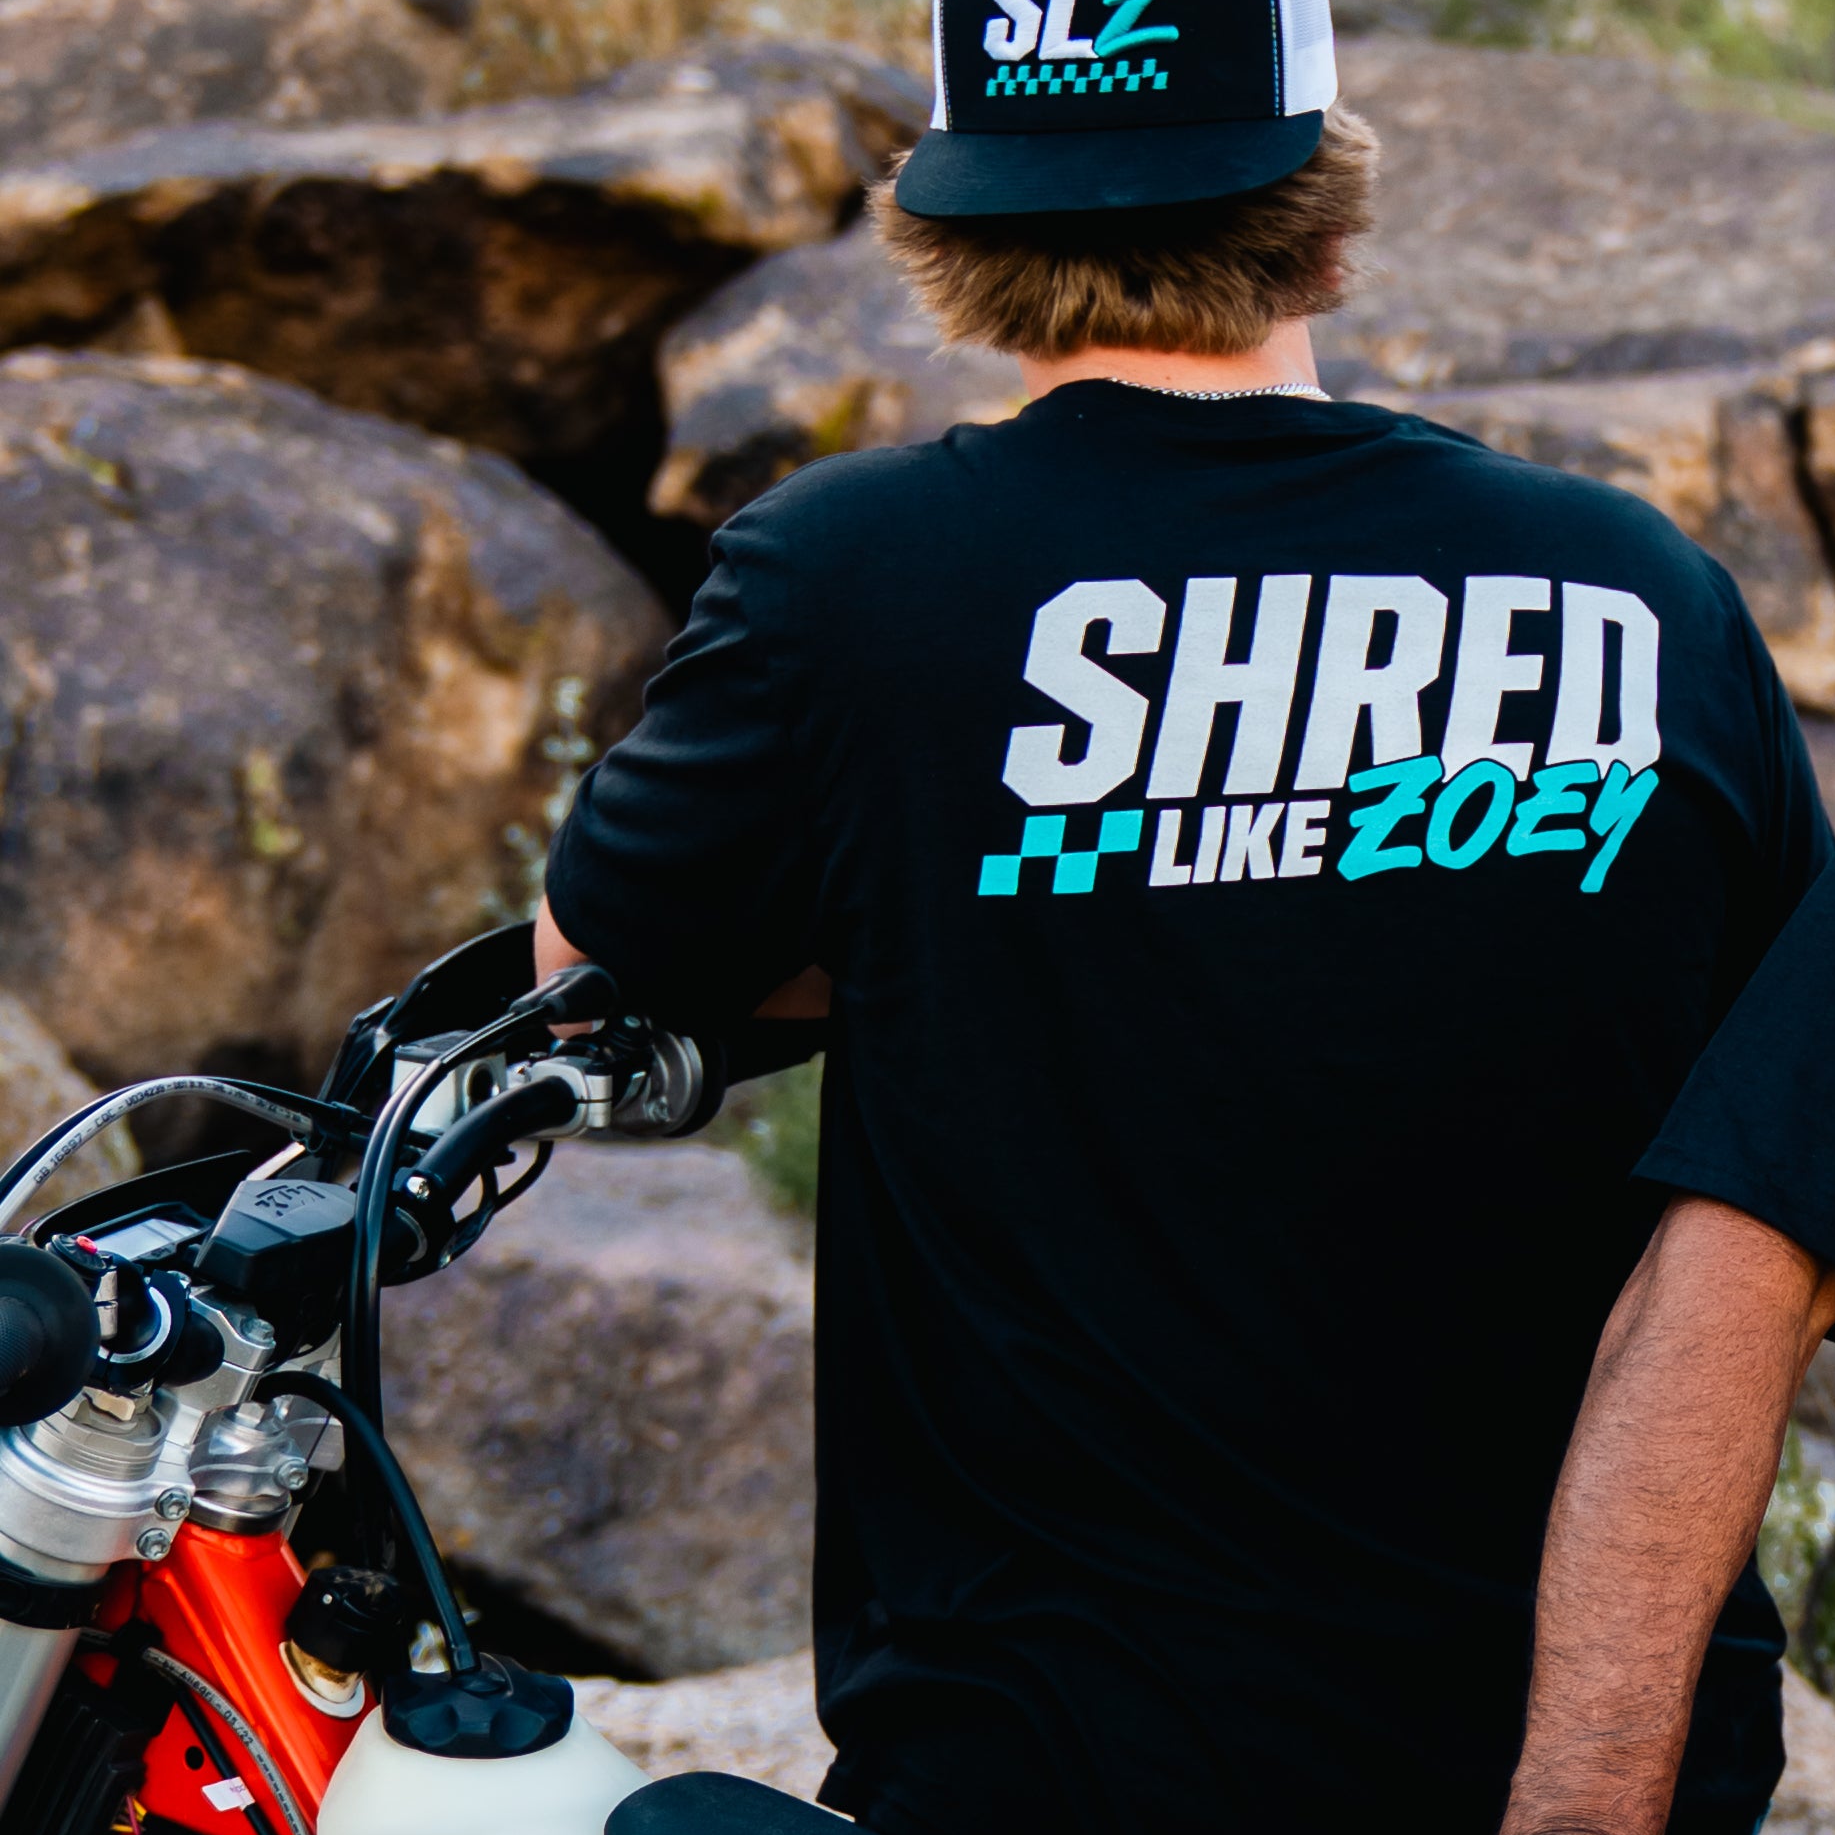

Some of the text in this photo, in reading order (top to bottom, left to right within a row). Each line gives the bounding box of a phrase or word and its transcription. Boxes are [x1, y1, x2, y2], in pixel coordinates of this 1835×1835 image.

[1002, 573, 1662, 807] SHRED
[1148, 754, 1661, 893] LIKE ZOEY
